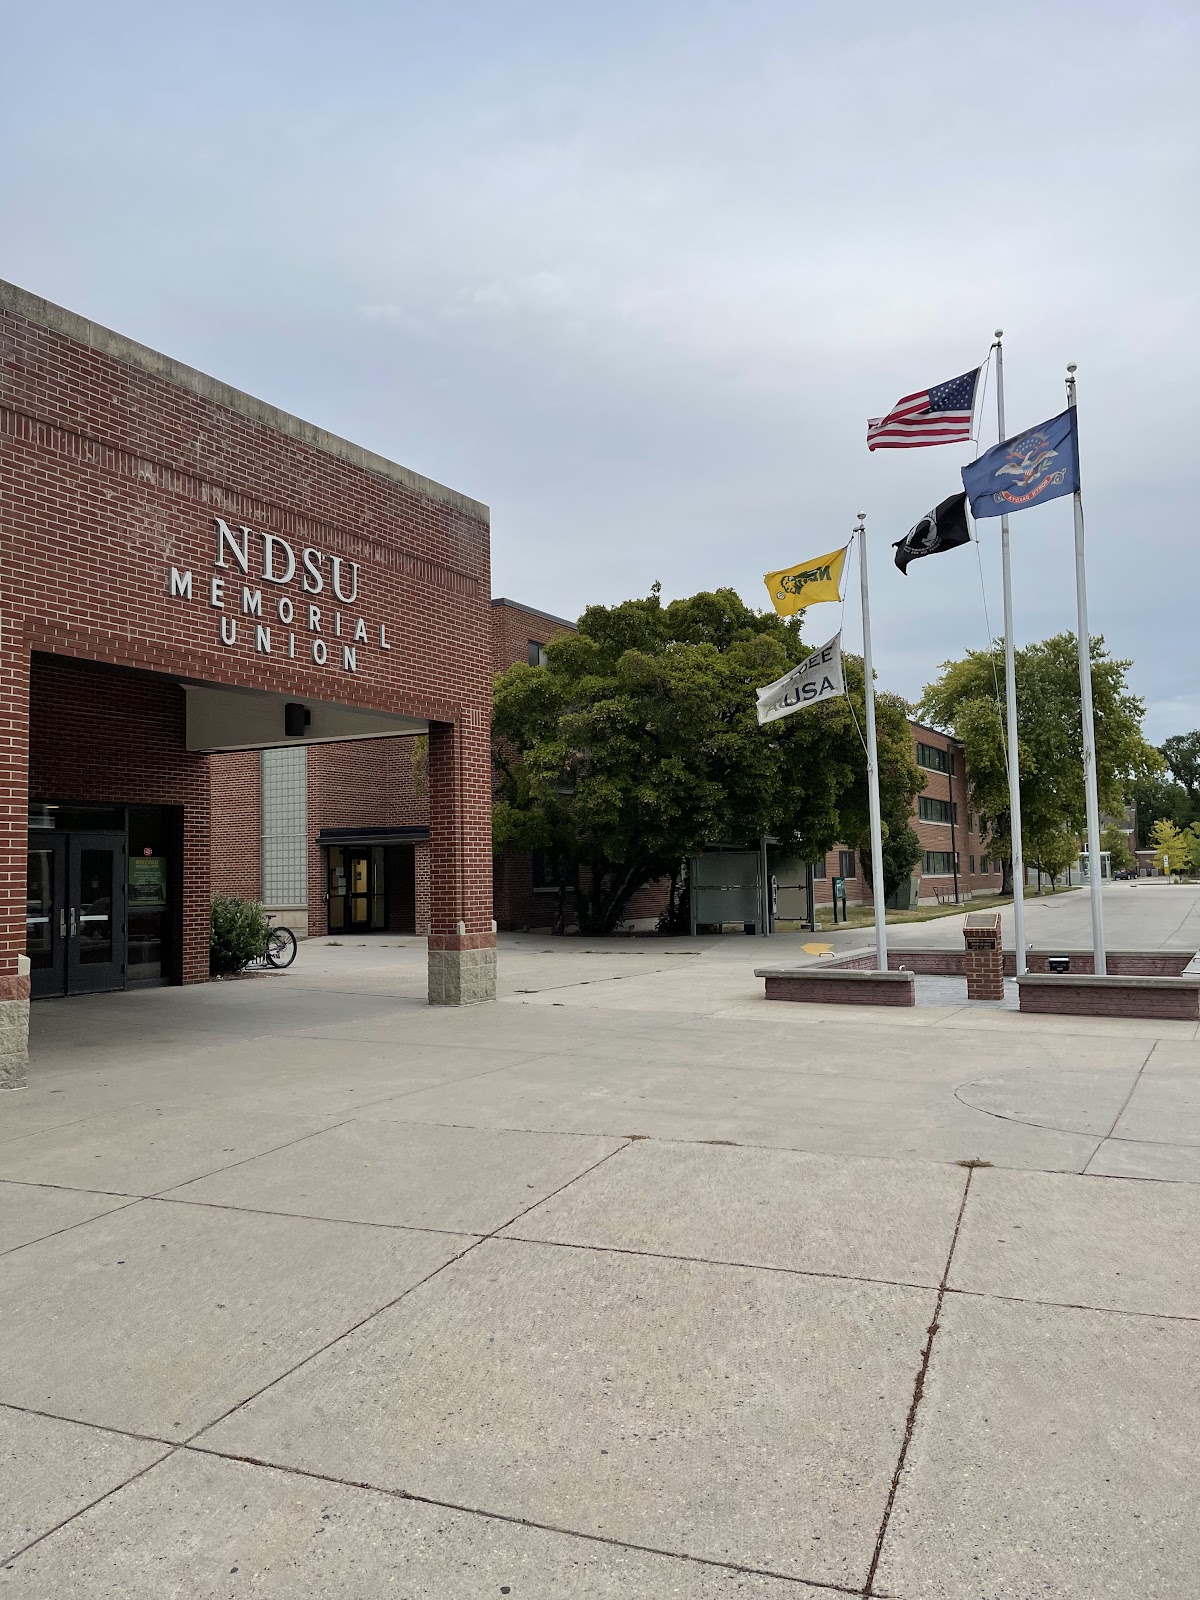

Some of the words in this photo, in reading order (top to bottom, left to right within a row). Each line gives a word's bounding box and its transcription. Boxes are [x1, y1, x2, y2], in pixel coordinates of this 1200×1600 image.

[214, 517, 360, 603] NDSU
[169, 567, 391, 649] MEMORIAL
[220, 616, 357, 672] UNION
[783, 675, 835, 707] USA
